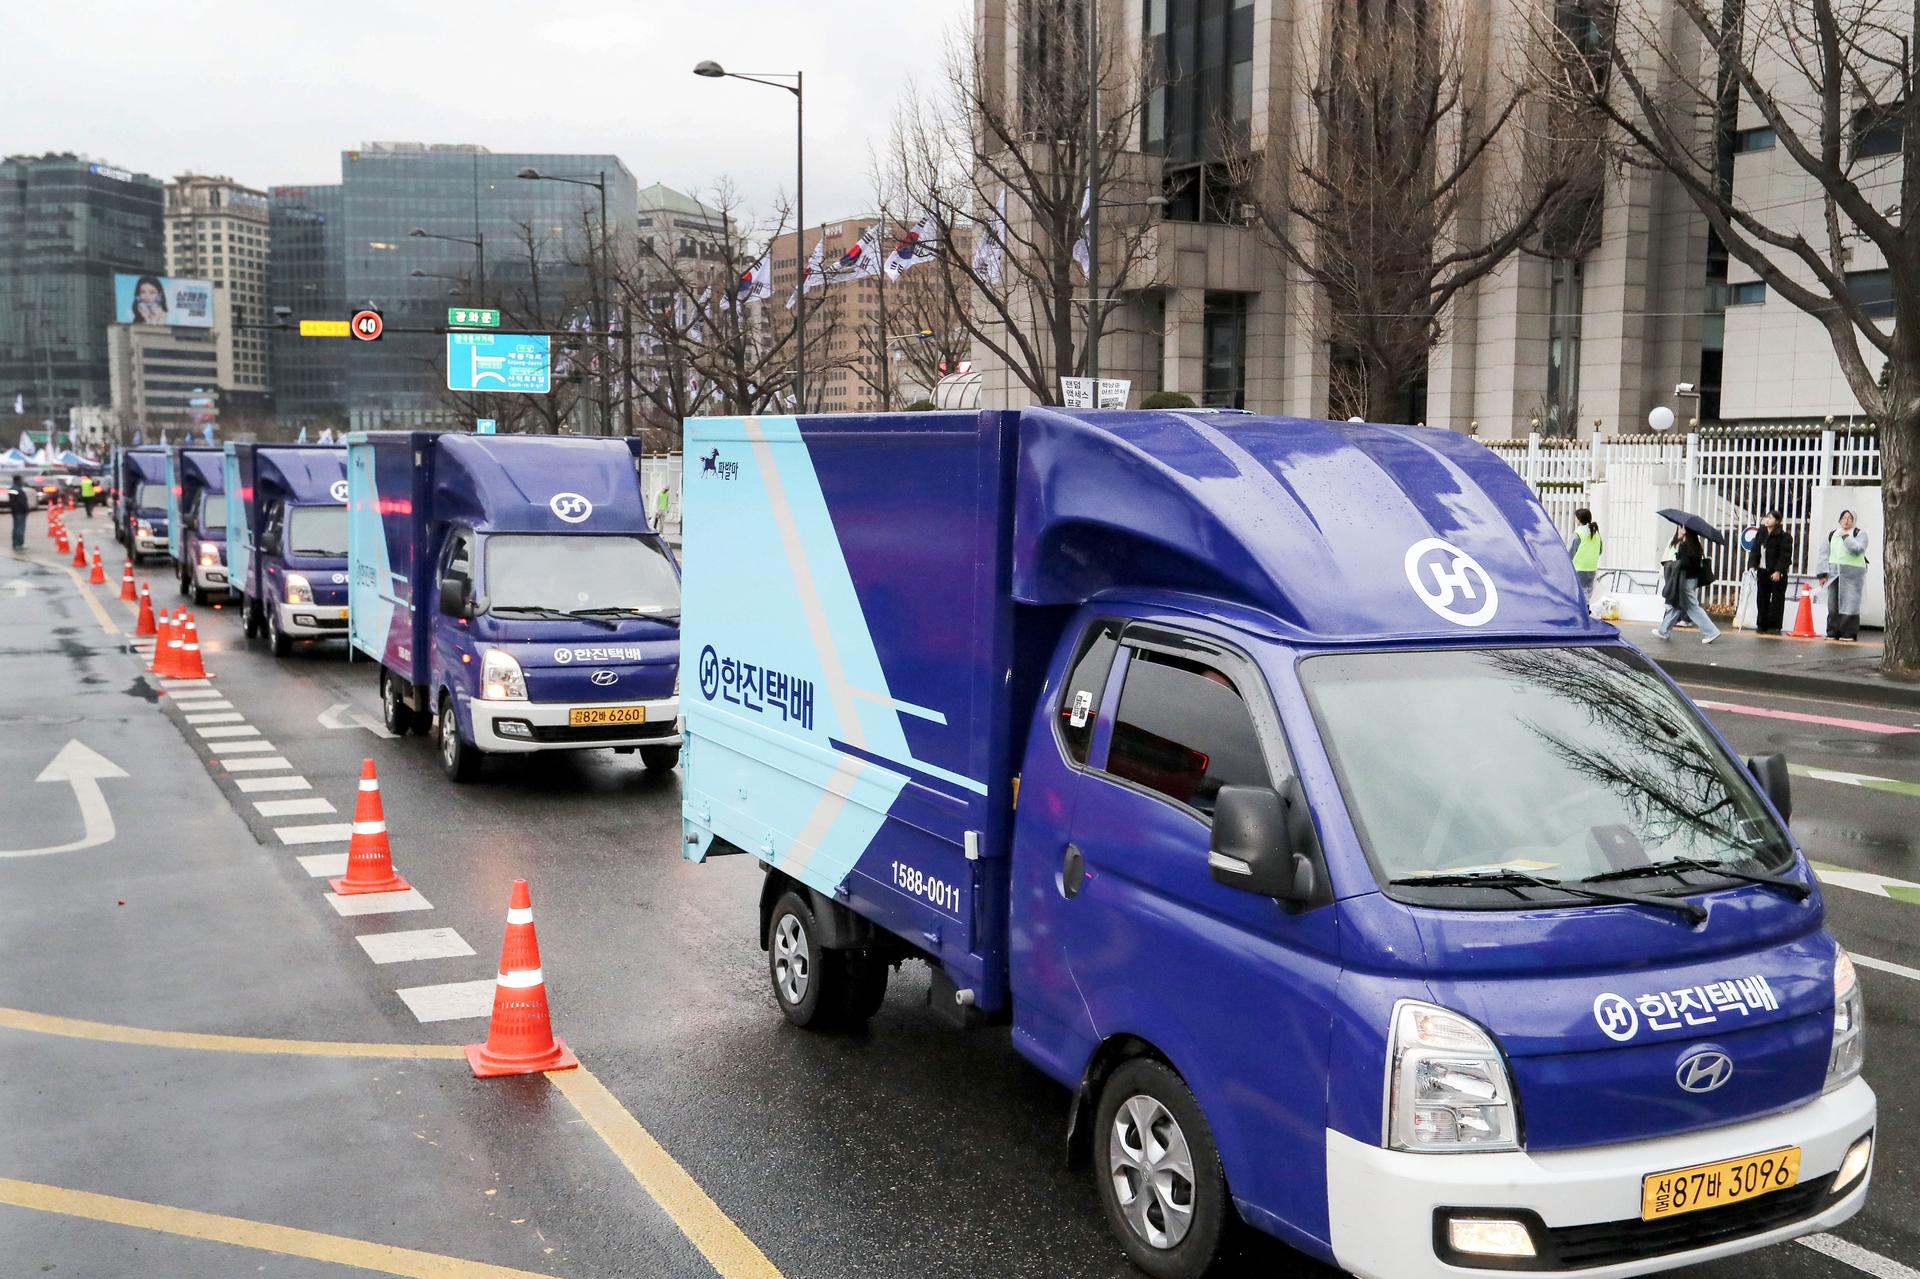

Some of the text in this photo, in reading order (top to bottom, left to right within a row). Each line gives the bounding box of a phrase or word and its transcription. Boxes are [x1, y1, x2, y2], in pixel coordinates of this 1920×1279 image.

[455, 311, 492, 324] 광화문
[358, 318, 376, 333] 40
[1065, 380, 1081, 389] 랜덤
[1066, 389, 1089, 399] 액세스
[718, 461, 739, 481] 파발마
[574, 648, 641, 662] 한진택배
[721, 657, 815, 731] 한진택배
[609, 709, 640, 722] 6260
[891, 860, 960, 913] 1588-0011
[1635, 975, 1780, 1032] 한진택배
[1728, 1155, 1790, 1198] 3096
